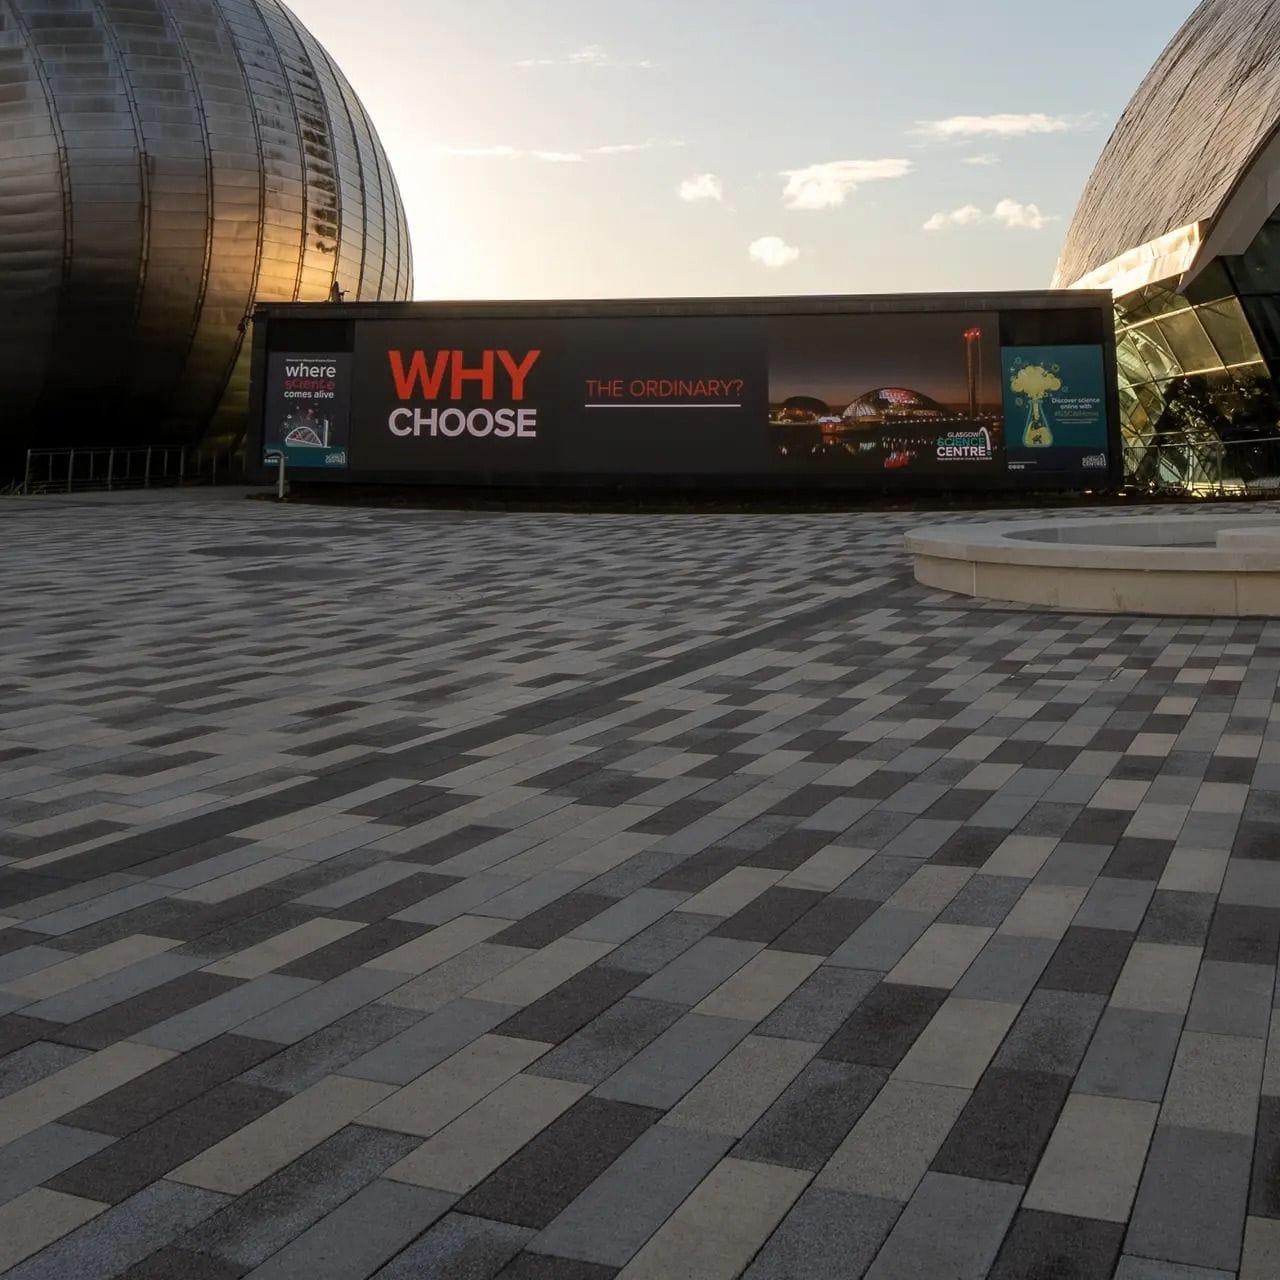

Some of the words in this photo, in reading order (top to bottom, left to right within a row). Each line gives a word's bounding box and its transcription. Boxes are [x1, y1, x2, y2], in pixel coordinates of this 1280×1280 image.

[285, 362, 336, 378] where
[388, 350, 541, 400] WHY
[284, 379, 336, 390] science
[585, 380, 624, 397] THE
[630, 379, 743, 397] ORDINARY?
[314, 390, 334, 399] alive
[388, 408, 537, 437] CHOOSE
[936, 437, 986, 446] SCIENCE
[936, 446, 986, 457] CENTRE
